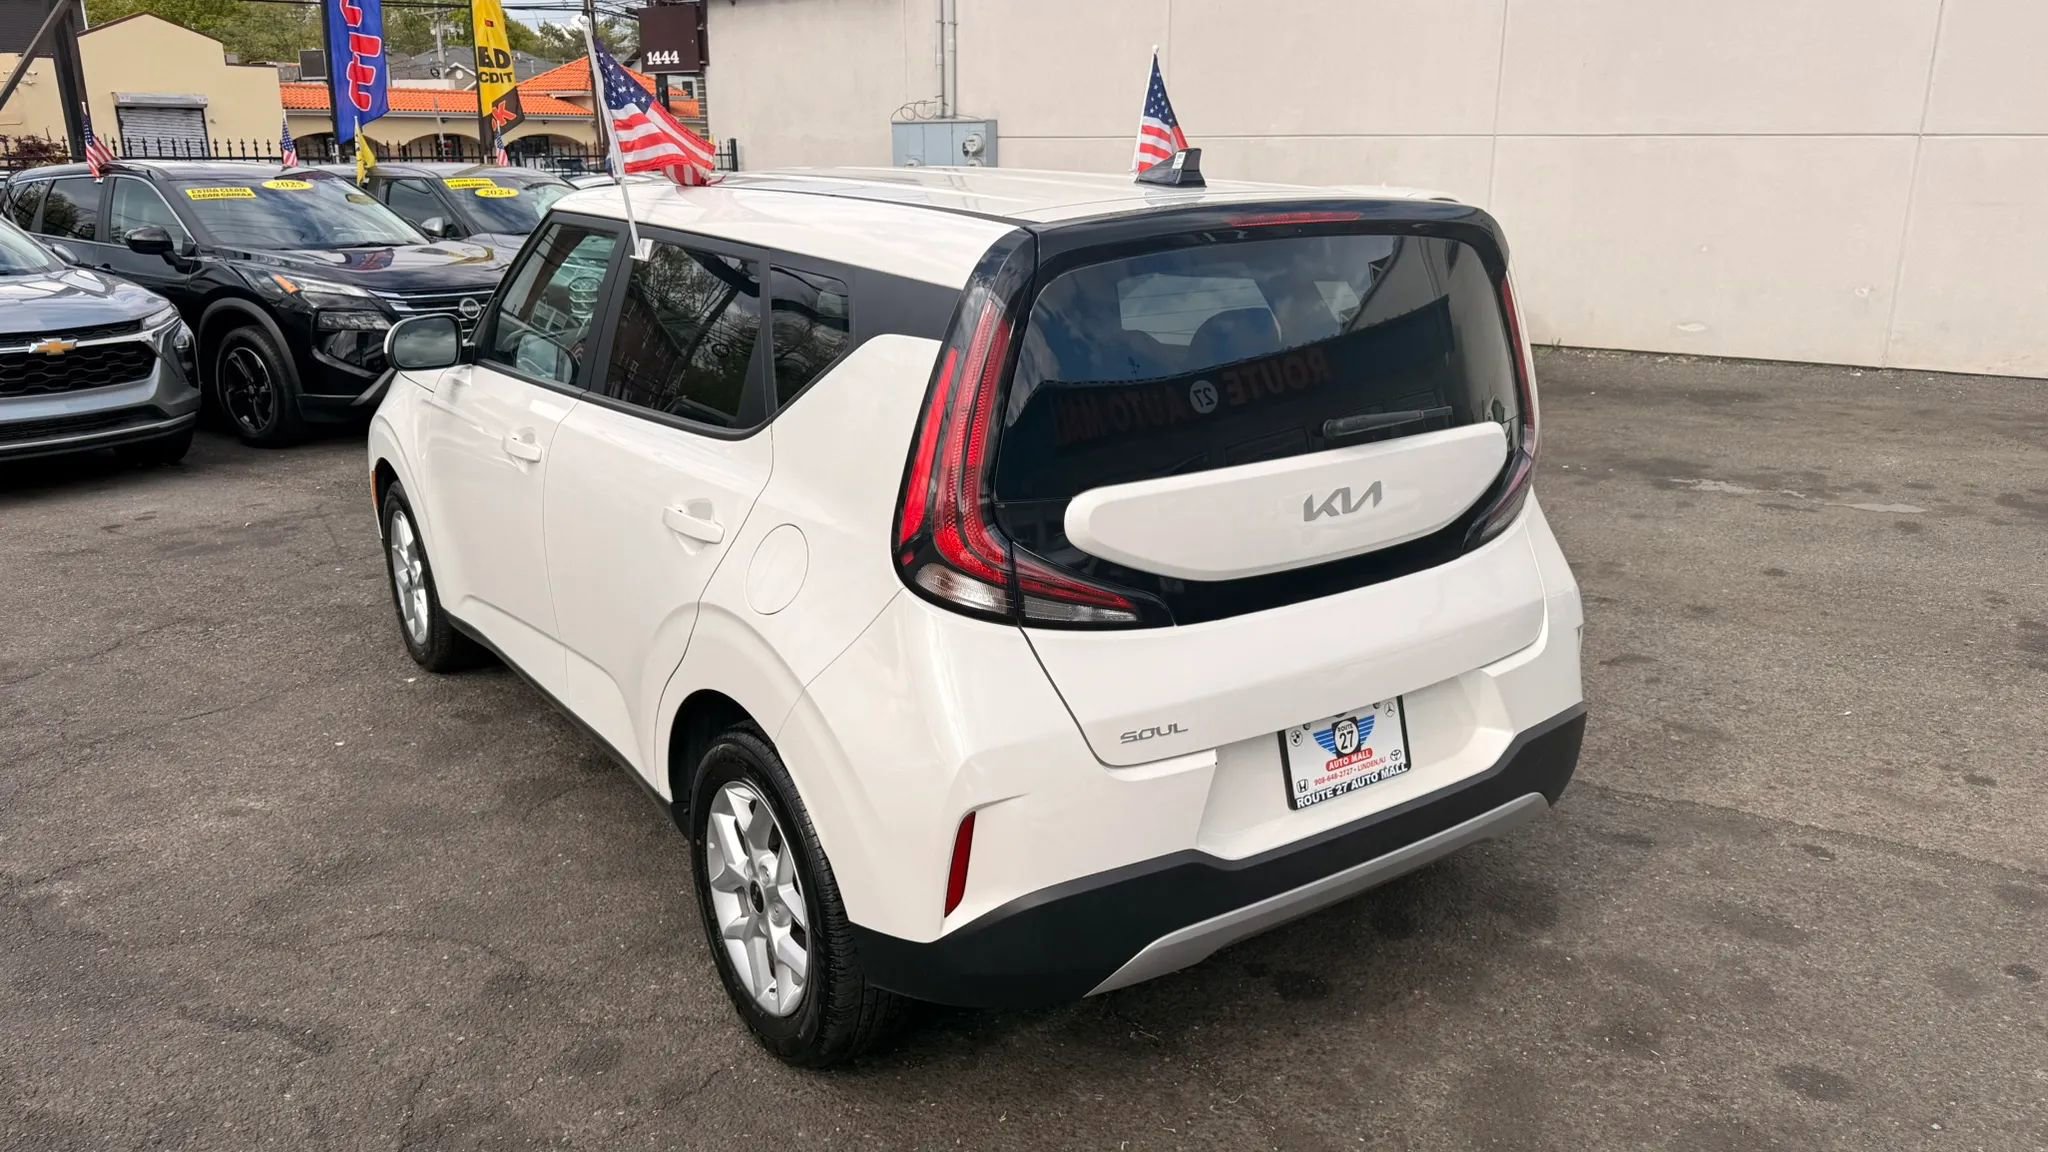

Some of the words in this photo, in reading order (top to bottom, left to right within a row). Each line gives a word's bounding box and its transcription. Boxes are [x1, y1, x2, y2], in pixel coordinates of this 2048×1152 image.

[646, 50, 680, 65] 1444
[274, 180, 305, 188] 2025
[1303, 480, 1382, 522] KIA
[1120, 723, 1188, 744] SOUL
[1337, 723, 1353, 732] ROUTE
[1339, 730, 1355, 751] 27
[1328, 757, 1349, 771] AUTO
[1351, 750, 1371, 765] MALL
[1296, 788, 1334, 809] ROUTE
[1335, 782, 1348, 795] 27
[1350, 772, 1379, 790] AUTO
[1381, 762, 1408, 779] MALL
